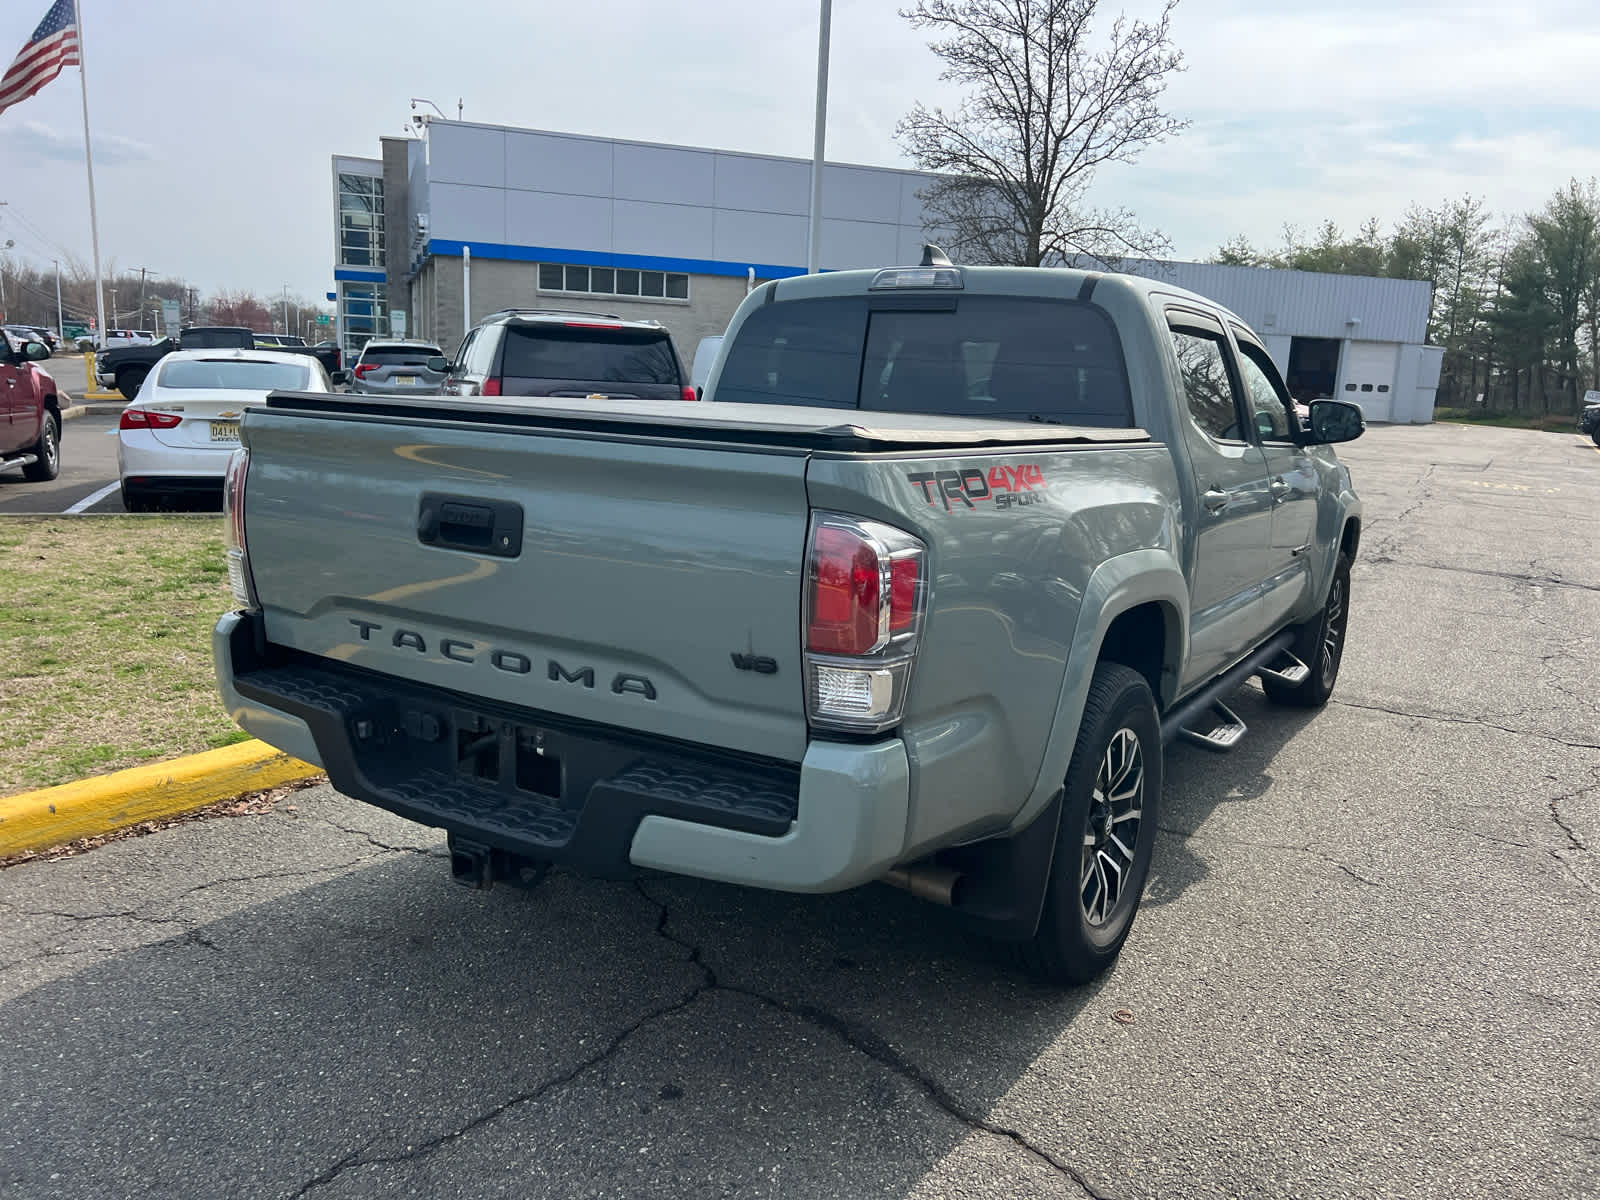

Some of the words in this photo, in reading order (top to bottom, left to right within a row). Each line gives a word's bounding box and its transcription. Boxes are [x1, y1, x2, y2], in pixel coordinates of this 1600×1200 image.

[907, 468, 992, 514] TRD
[349, 618, 657, 701] TACOMA
[730, 652, 779, 675] V6
